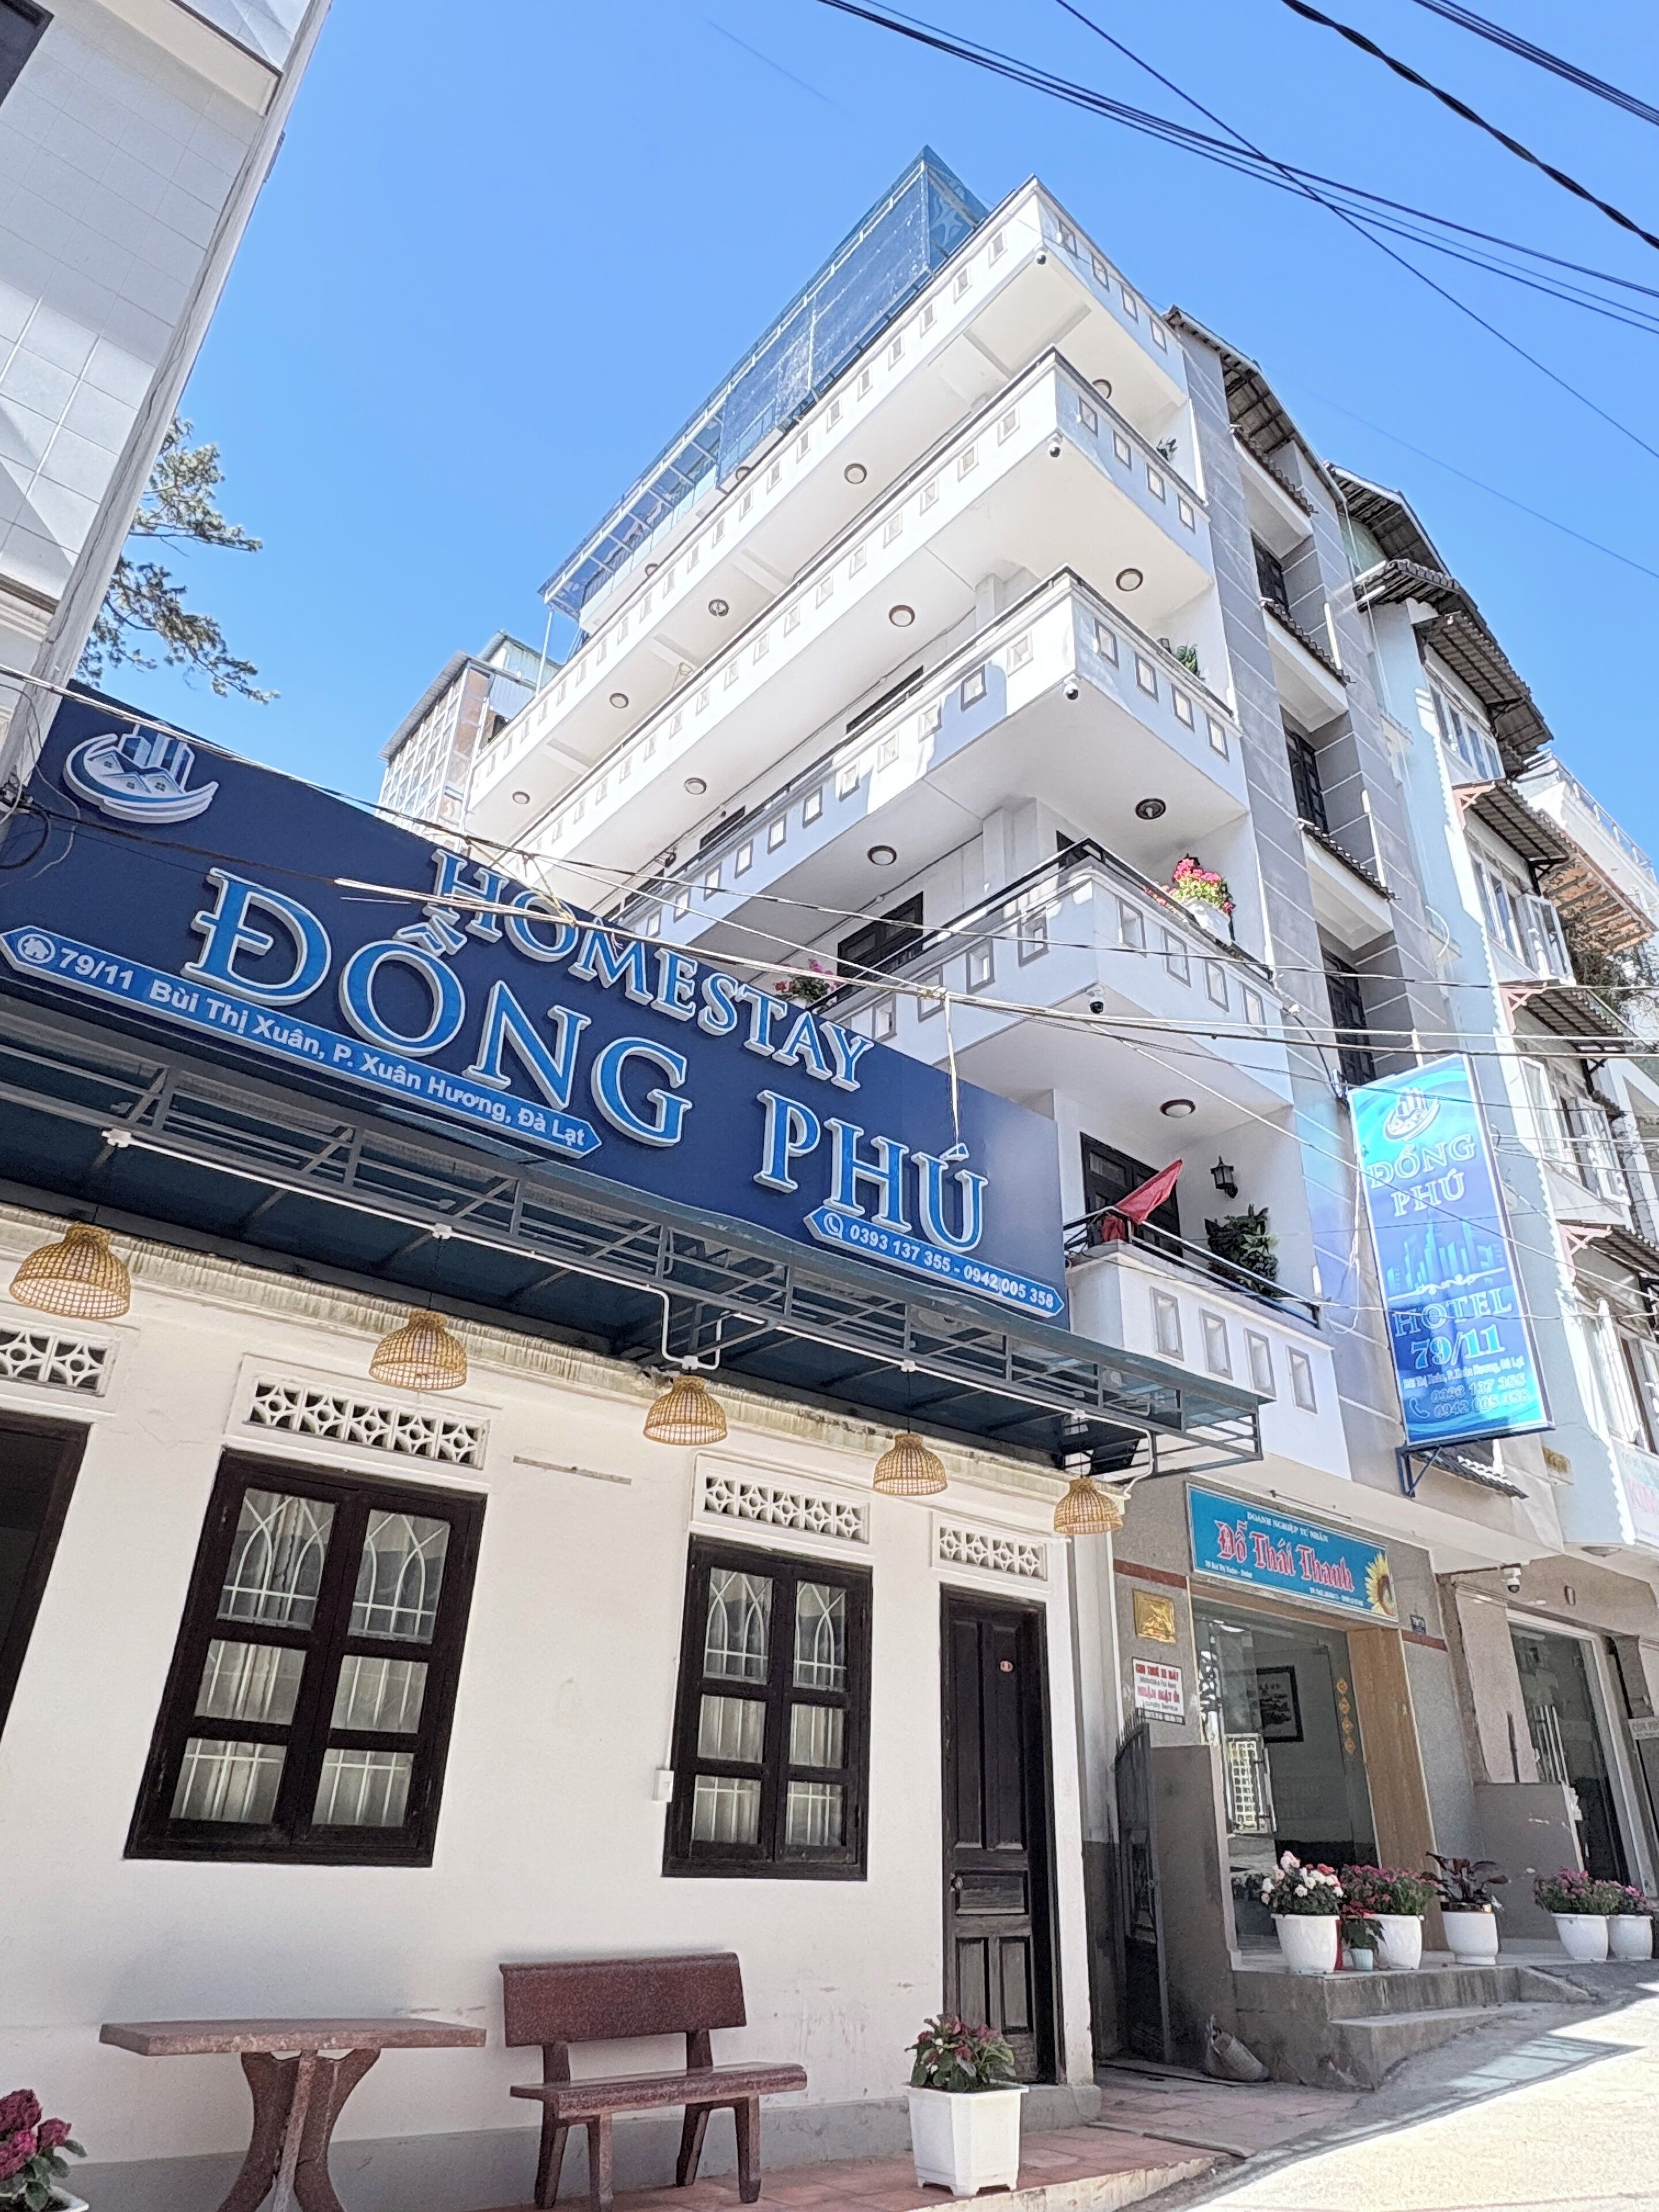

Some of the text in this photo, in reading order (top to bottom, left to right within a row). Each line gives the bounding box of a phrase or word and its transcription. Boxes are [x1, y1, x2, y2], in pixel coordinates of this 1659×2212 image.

[430, 849, 874, 1092] HOMESTAY
[59, 948, 585, 1147] 79/11 Bùi Thị Xuân, P. Xuân Hương, Đà Lạt
[181, 868, 988, 1253] ĐỒNG PHÚ
[1391, 1168, 1465, 1217] PHÚ
[850, 1225, 888, 1251] 0393
[893, 1240, 921, 1261] 137
[924, 1250, 951, 1272] 355
[963, 1264, 998, 1289] 0942
[1001, 1281, 1027, 1298] 005
[1029, 1289, 1054, 1309] 358
[1392, 1287, 1512, 1338] HOTEL
[1411, 1324, 1506, 1369] 79/11
[1434, 1399, 1469, 1419] 0942
[1469, 1378, 1495, 1396] 137
[1214, 1519, 1355, 1593] Đỗ Thái Thanh
